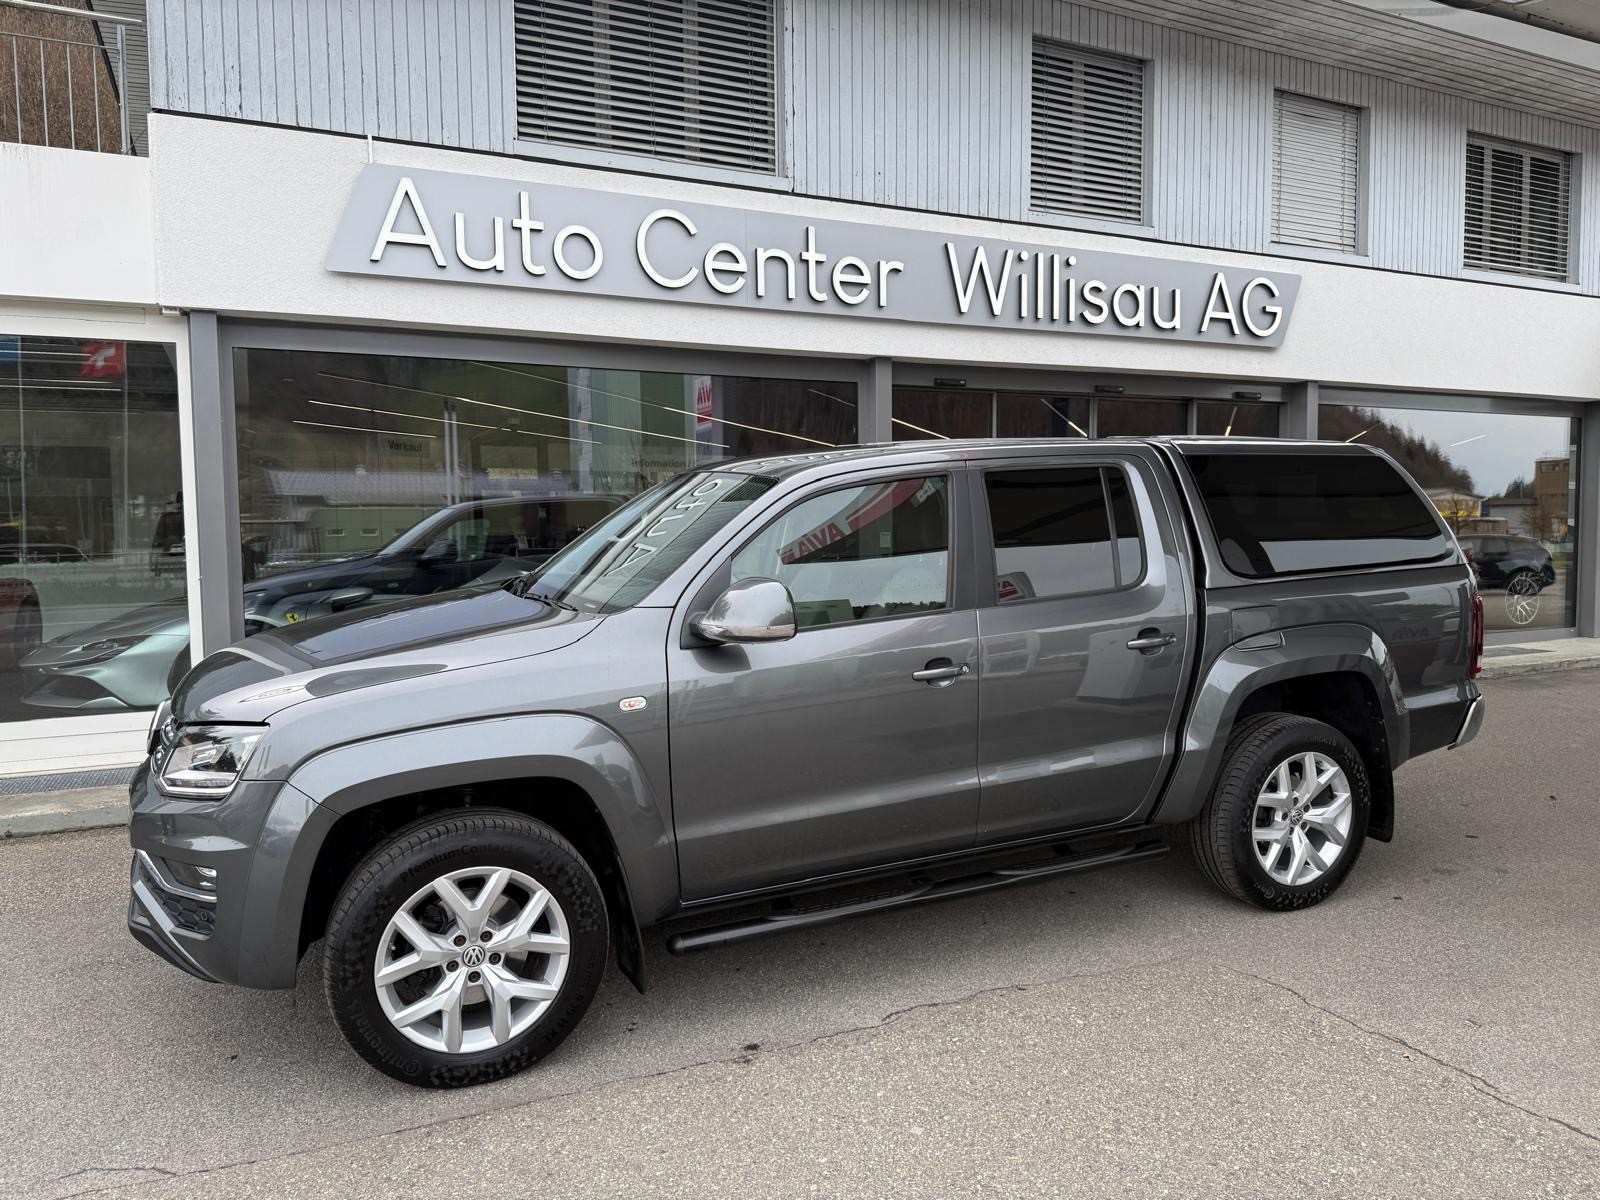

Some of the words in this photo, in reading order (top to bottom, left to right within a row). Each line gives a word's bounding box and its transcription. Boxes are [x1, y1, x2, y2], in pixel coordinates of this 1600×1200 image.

[370, 177, 604, 280] Auto
[635, 208, 905, 308] Center
[945, 242, 1181, 330] Willisau
[1200, 271, 1283, 338] AG
